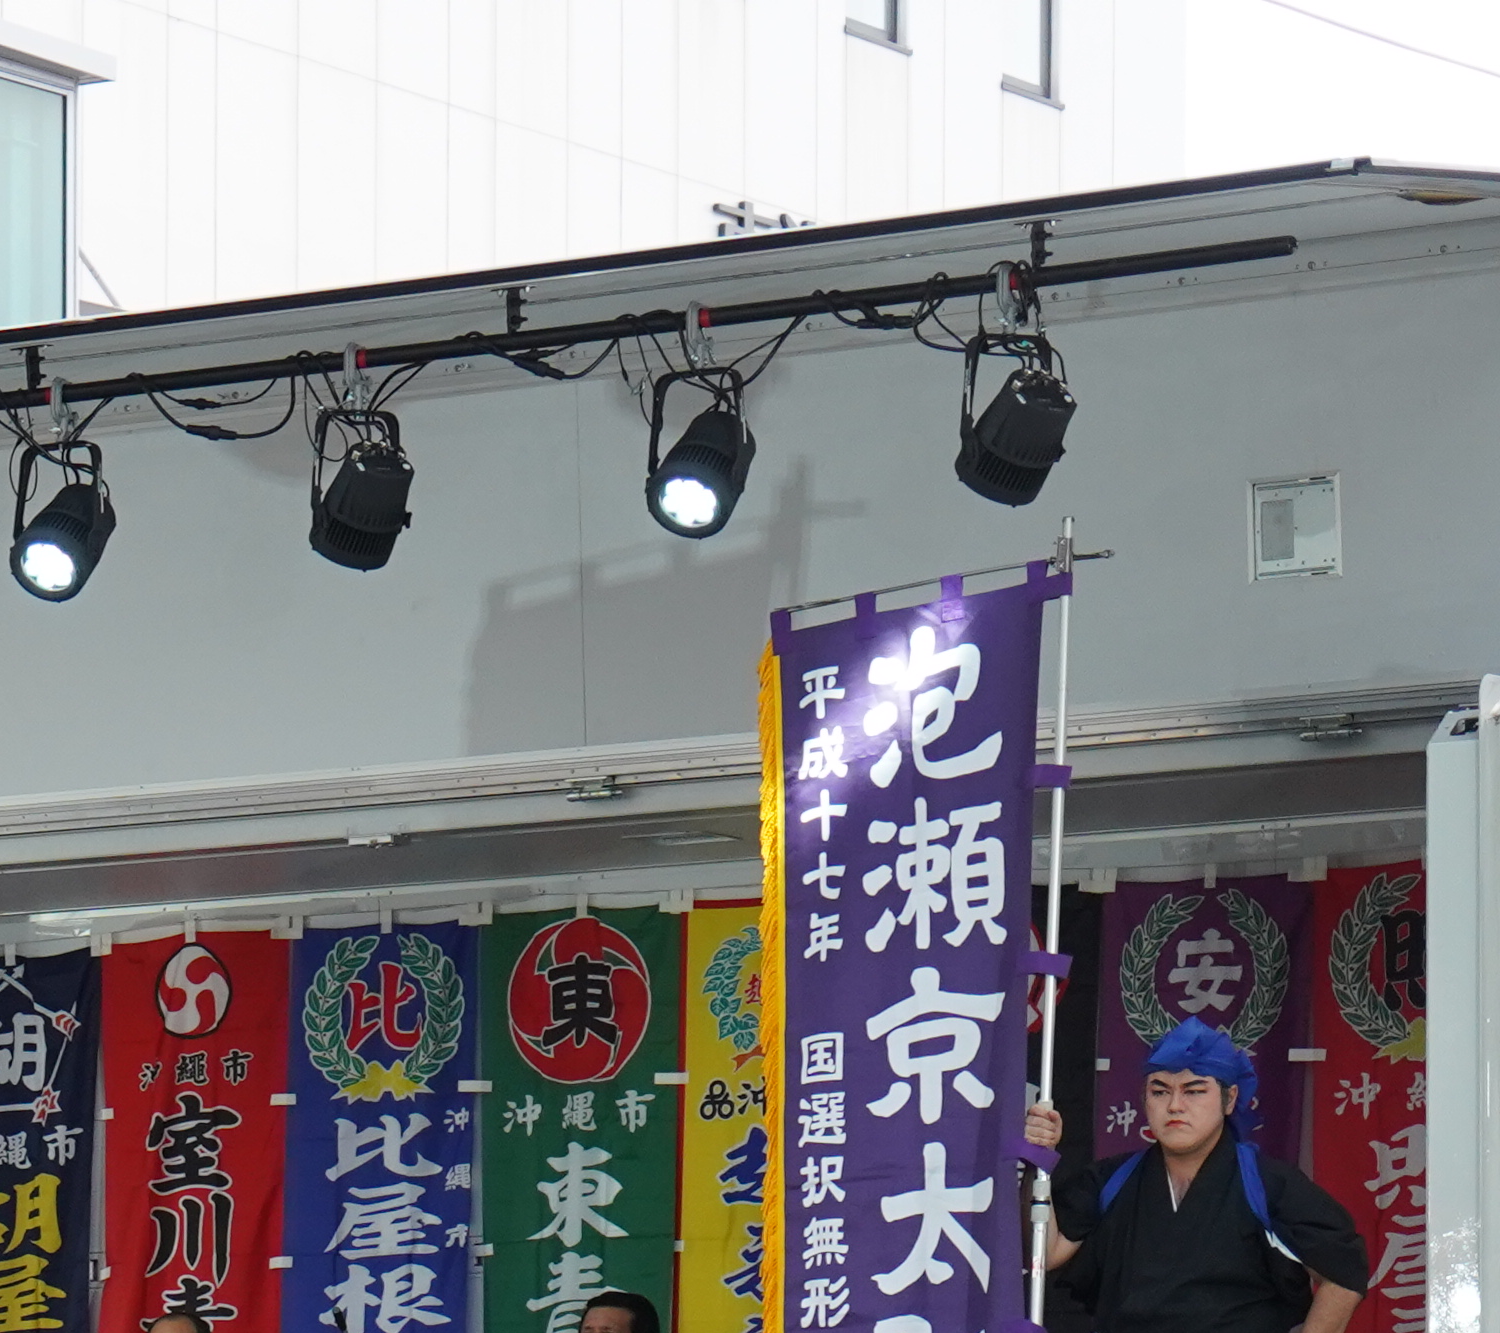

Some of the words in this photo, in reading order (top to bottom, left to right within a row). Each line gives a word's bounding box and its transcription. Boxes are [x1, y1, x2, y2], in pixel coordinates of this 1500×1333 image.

[799, 665, 848, 962] 平成十七年
[347, 960, 423, 1052] 比
[540, 952, 621, 1048] 東
[1167, 928, 1243, 1013] 安
[503, 1089, 656, 1137] 沖縄市
[443, 1107, 471, 1248] 沖縄市
